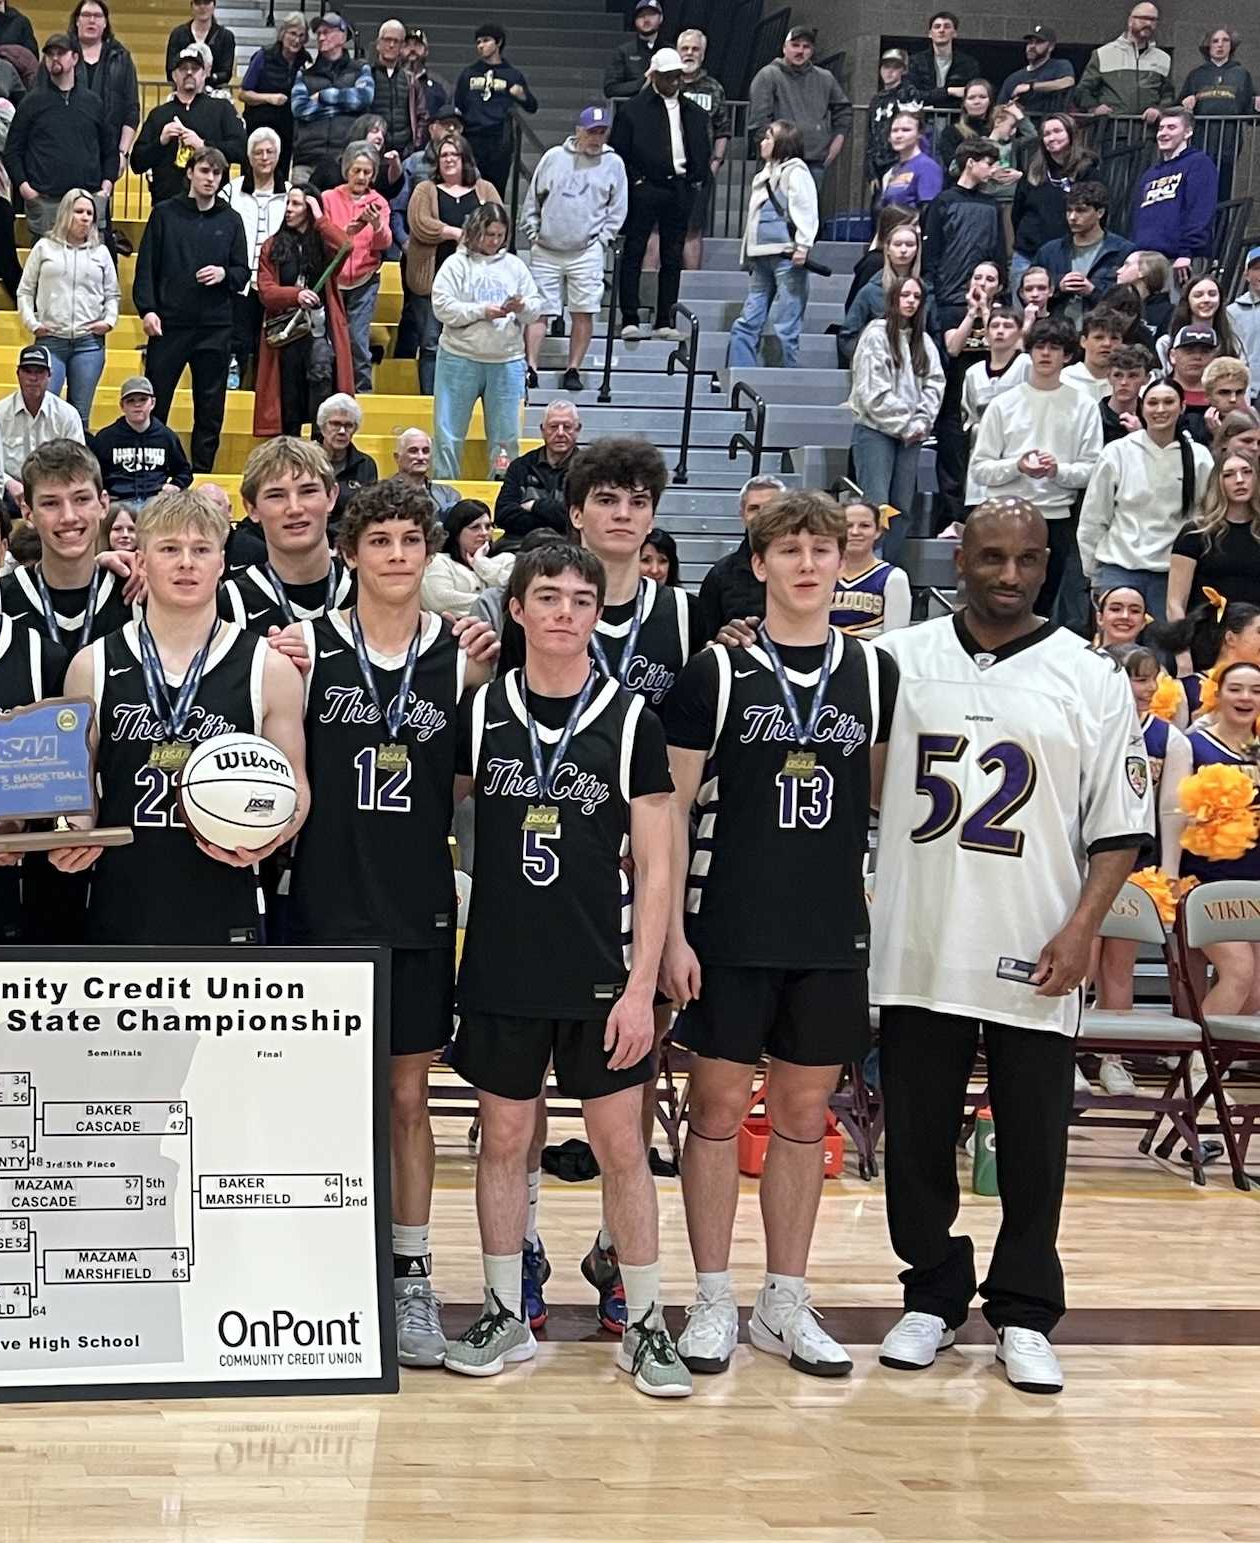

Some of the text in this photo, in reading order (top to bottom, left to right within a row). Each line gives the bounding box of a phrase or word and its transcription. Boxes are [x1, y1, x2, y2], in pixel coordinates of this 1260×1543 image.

[623, 655, 675, 704] City
[319, 686, 448, 742] The City
[111, 703, 167, 741] The
[740, 704, 868, 757] The City
[214, 750, 291, 778] Wilson
[13, 770, 86, 784] BASKETBALL
[354, 747, 412, 813] 12
[484, 757, 610, 815] The City
[775, 765, 835, 830] 13
[909, 732, 1038, 858] 52
[522, 823, 561, 887] 5
[84, 977, 191, 999] Credit
[207, 977, 304, 999] Union
[7, 1009, 100, 1032] State
[117, 1009, 361, 1037] Championship
[86, 1048, 143, 1058] Semifinals
[256, 1050, 283, 1059] Final
[12, 1074, 28, 1086] 34
[12, 1091, 29, 1103] 56
[85, 1103, 184, 1116] BAKER 66
[75, 1120, 185, 1133] CASCADE 47
[10, 1139, 26, 1150] 54
[86, 1160, 117, 1169] Place
[14, 1177, 166, 1191] MAZAMA 57 5th
[218, 1176, 364, 1189] BAKER 64 1st
[10, 1194, 167, 1208] CASCADE 67 3rd
[205, 1192, 368, 1208] MARSHFIELD 46 2nd
[10, 1218, 27, 1231] 58
[15, 1237, 30, 1250] 52
[78, 1250, 186, 1263] MAZAMA 43
[64, 1267, 187, 1280] MARSHFIELD 65
[12, 1285, 28, 1297] 41
[31, 1305, 47, 1317] 64
[218, 1310, 362, 1348] OnPoint
[29, 1336, 70, 1352] High
[77, 1334, 140, 1349] School
[218, 1351, 363, 1368] COMMUNITY CREDIT UNION
